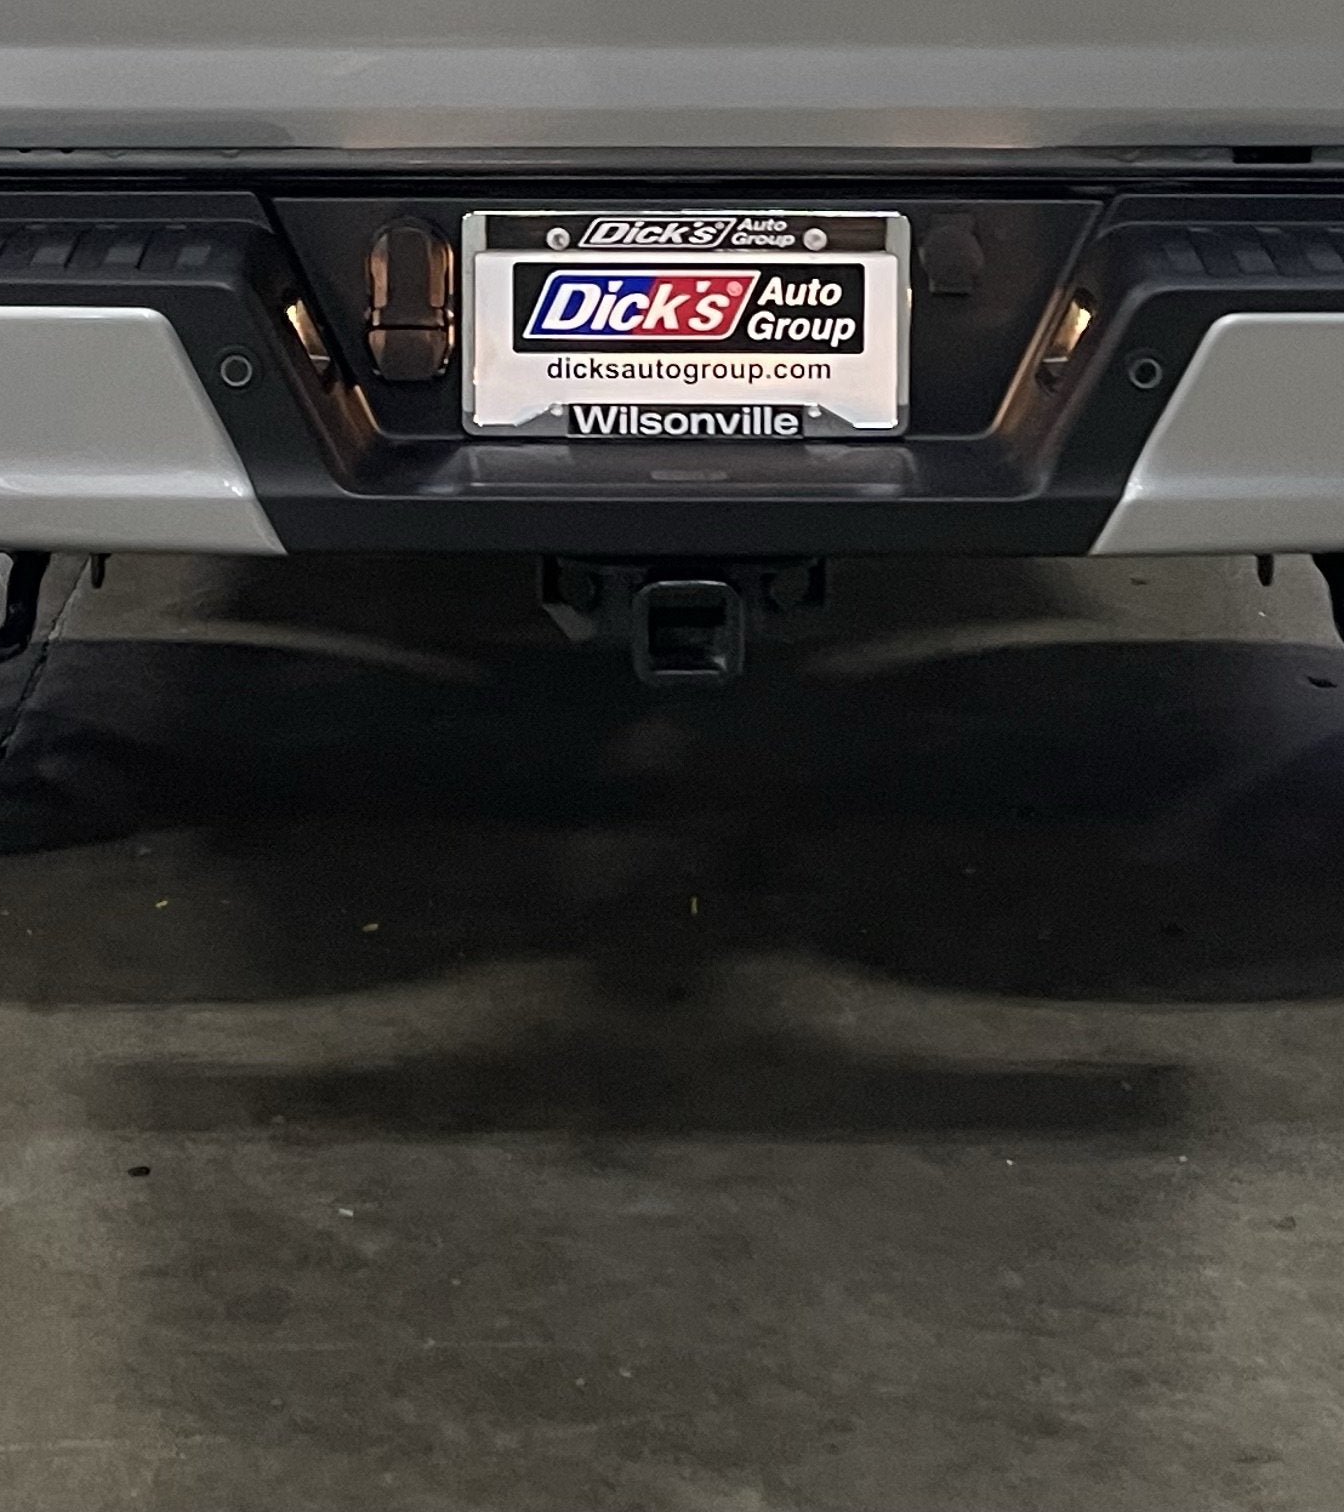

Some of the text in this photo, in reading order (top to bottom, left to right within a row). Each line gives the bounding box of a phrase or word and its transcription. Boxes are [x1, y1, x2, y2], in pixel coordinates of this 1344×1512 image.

[589, 218, 788, 244] Dick's Auto
[731, 232, 796, 248] Group
[541, 276, 842, 331] Dick's Auto
[747, 311, 856, 348] Group
[546, 357, 831, 385] dicksautogroup.com
[573, 404, 800, 436] Wilsonville
